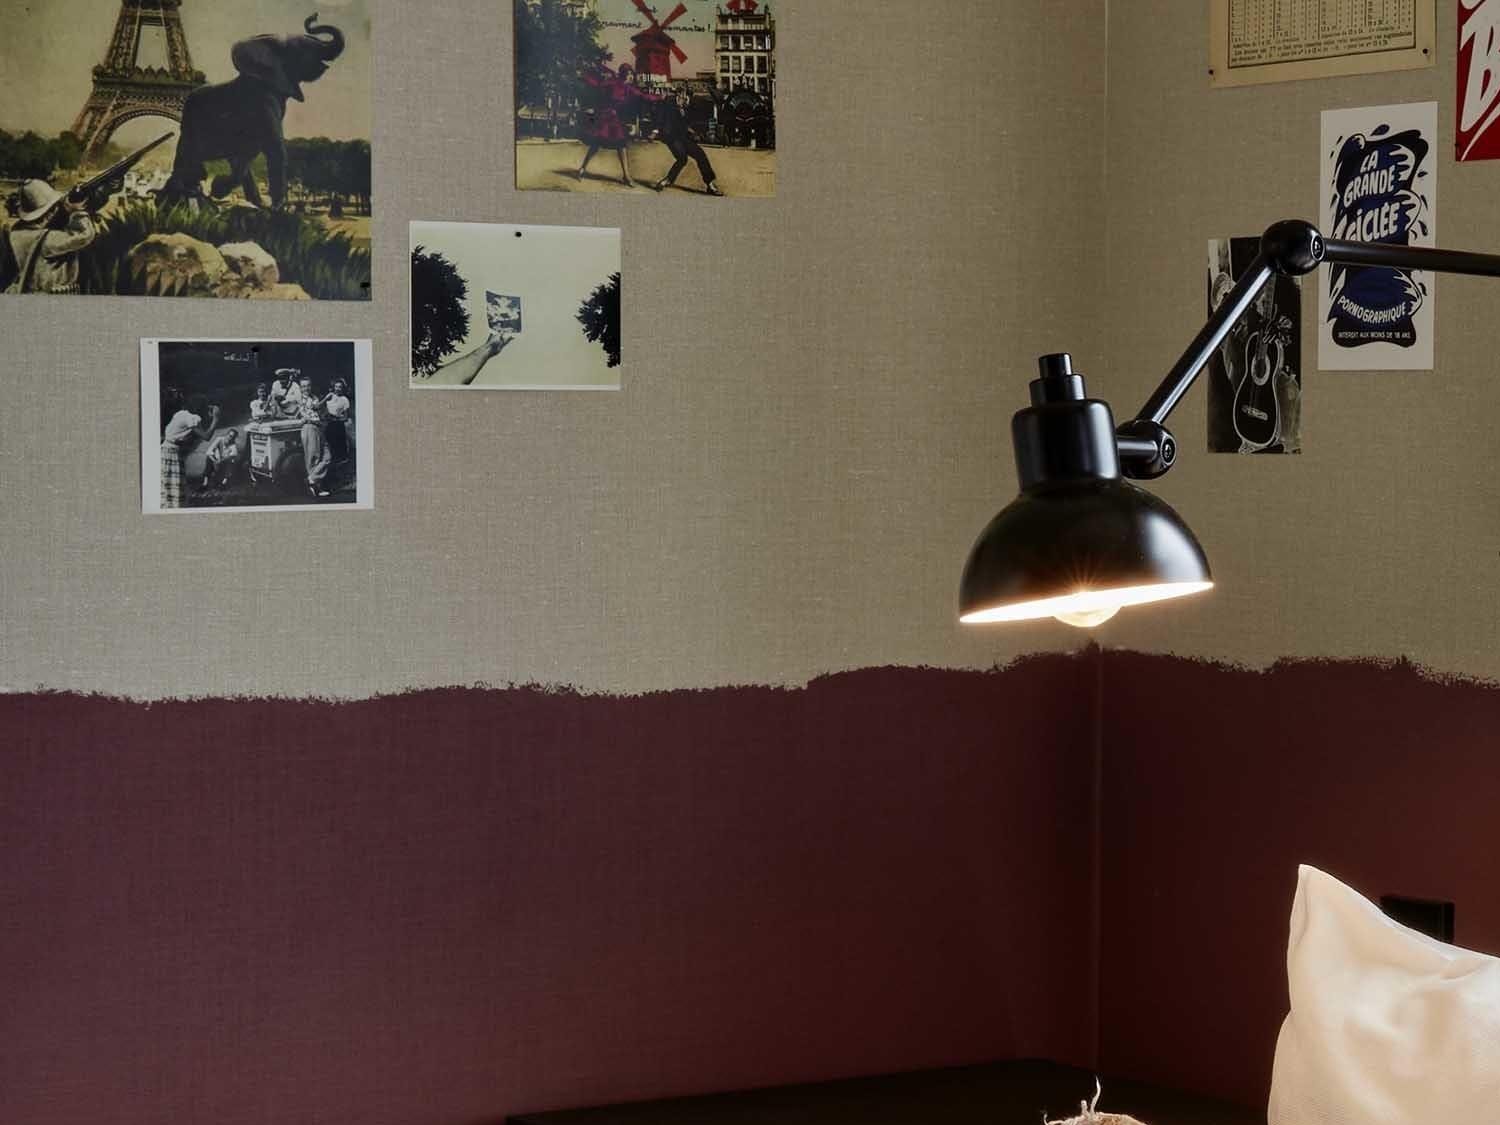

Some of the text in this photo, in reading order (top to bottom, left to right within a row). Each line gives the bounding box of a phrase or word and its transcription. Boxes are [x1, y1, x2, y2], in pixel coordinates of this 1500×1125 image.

[1360, 150, 1379, 173] LA
[1344, 165, 1396, 208] GRANDE
[1337, 295, 1406, 324] PORNOGRAPHIQUE
